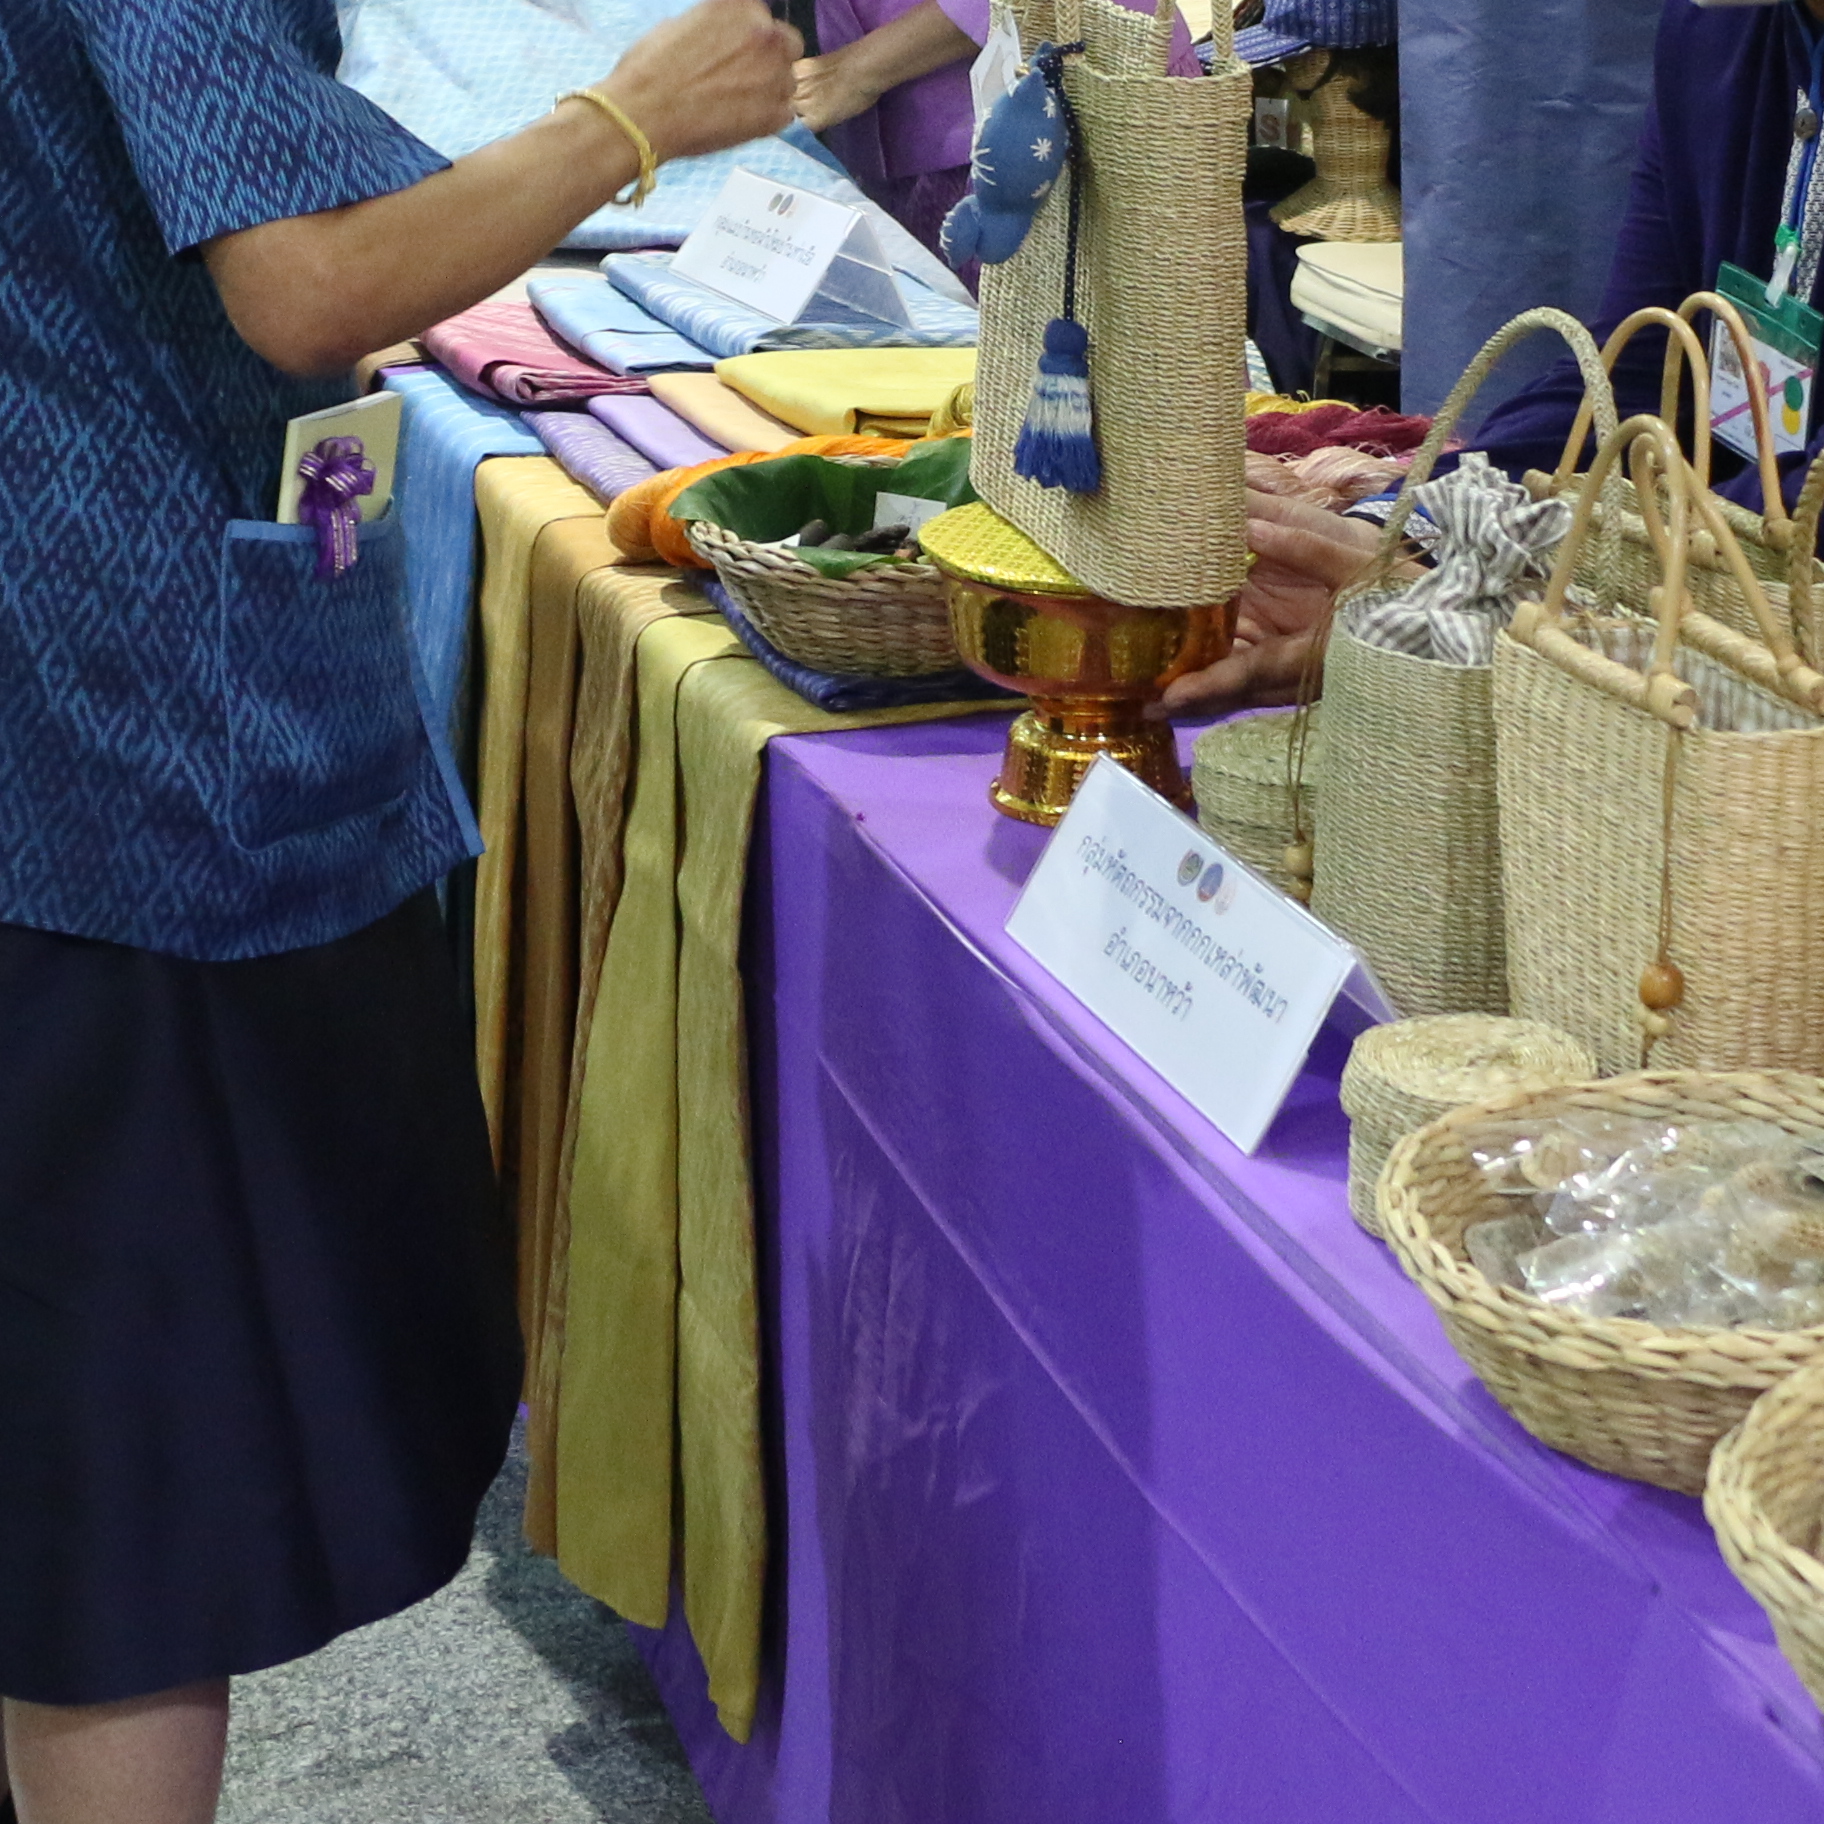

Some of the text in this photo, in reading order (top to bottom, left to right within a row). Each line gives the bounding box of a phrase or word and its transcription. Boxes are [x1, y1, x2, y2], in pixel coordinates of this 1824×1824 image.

[1103, 927, 1194, 1022] อำเภอนาหว้า
